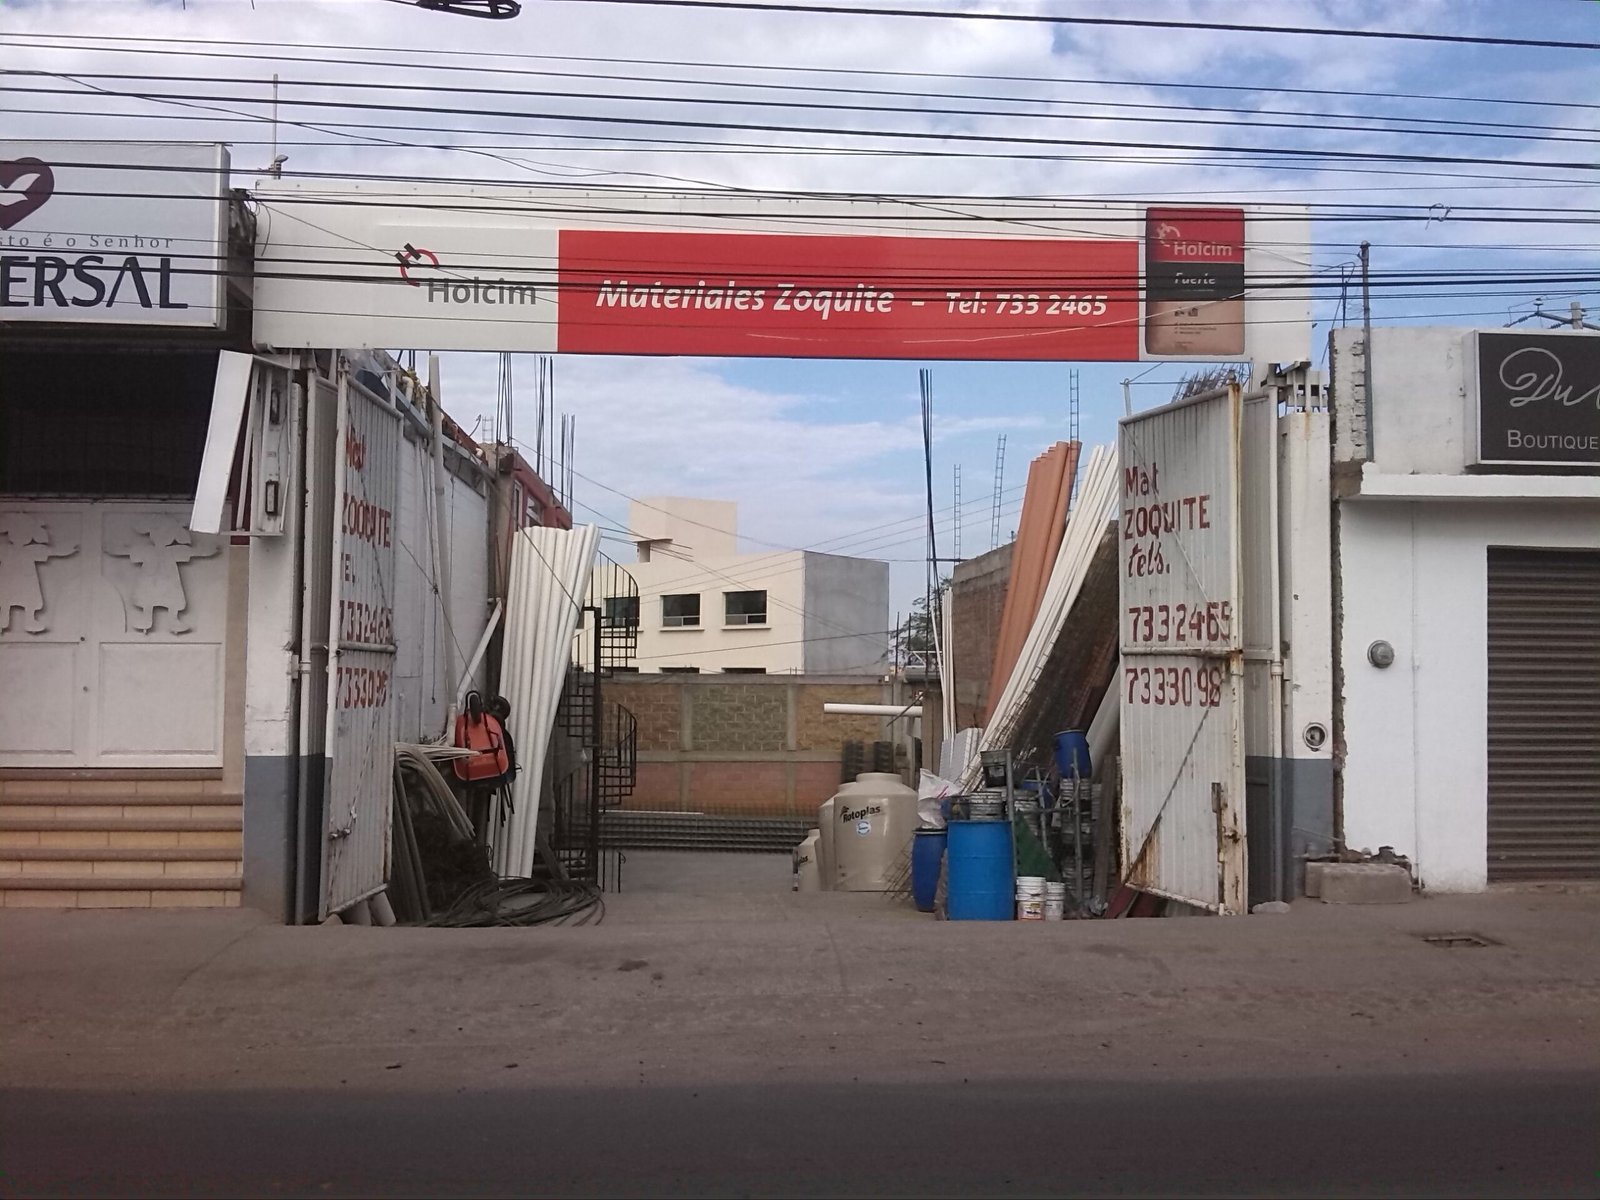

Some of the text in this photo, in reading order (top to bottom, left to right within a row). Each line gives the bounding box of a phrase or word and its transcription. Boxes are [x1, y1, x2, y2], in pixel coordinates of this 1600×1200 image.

[43, 233, 53, 247] é
[66, 237, 77, 249] o
[89, 234, 174, 249] Senhor
[1173, 241, 1233, 257] Holcim
[0, 254, 189, 309] ERSAL
[427, 276, 538, 306] Holcim
[595, 280, 766, 311] Materiales
[773, 283, 895, 321] Zoquite
[946, 291, 988, 315] Tel:
[996, 293, 1040, 315] 733
[1045, 294, 1108, 316] 2465
[1507, 429, 1599, 450] BOUTIQUE
[1125, 462, 1160, 498] Mat
[1124, 495, 1211, 541] ZOQUITE
[842, 806, 881, 823] Rotoplas
